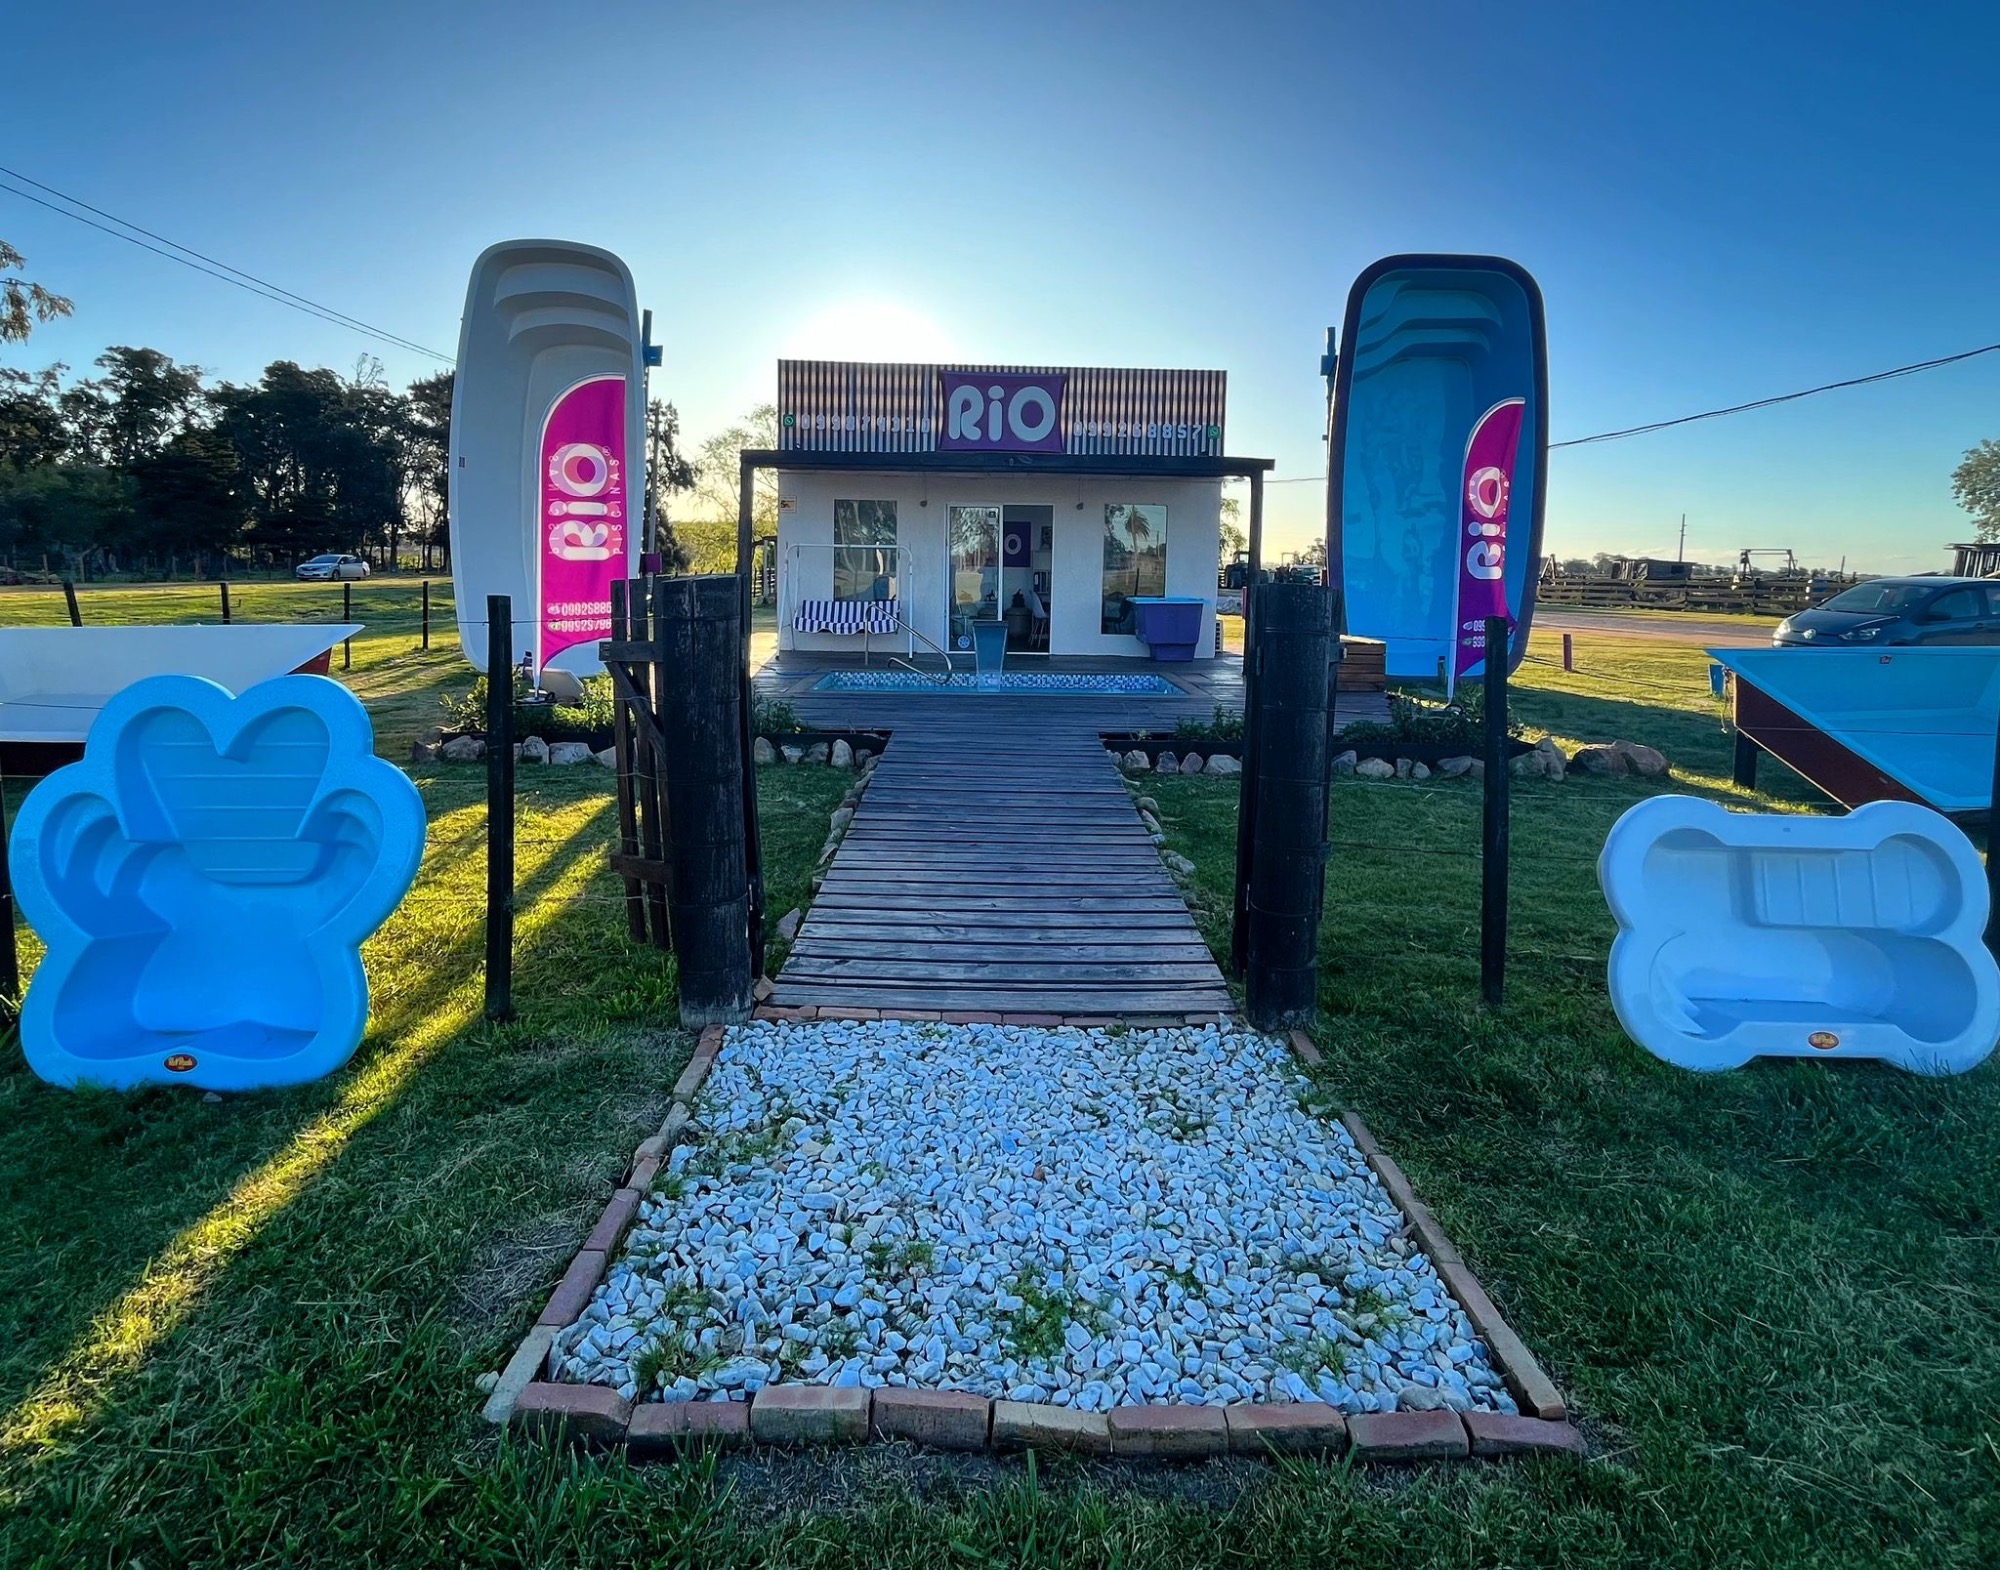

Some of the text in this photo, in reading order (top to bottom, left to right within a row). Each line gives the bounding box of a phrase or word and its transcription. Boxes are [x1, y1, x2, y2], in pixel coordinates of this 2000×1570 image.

[801, 413, 930, 433] 099874310
[1073, 420, 1202, 440] 099268857
[609, 459, 623, 555] PISCINAS
